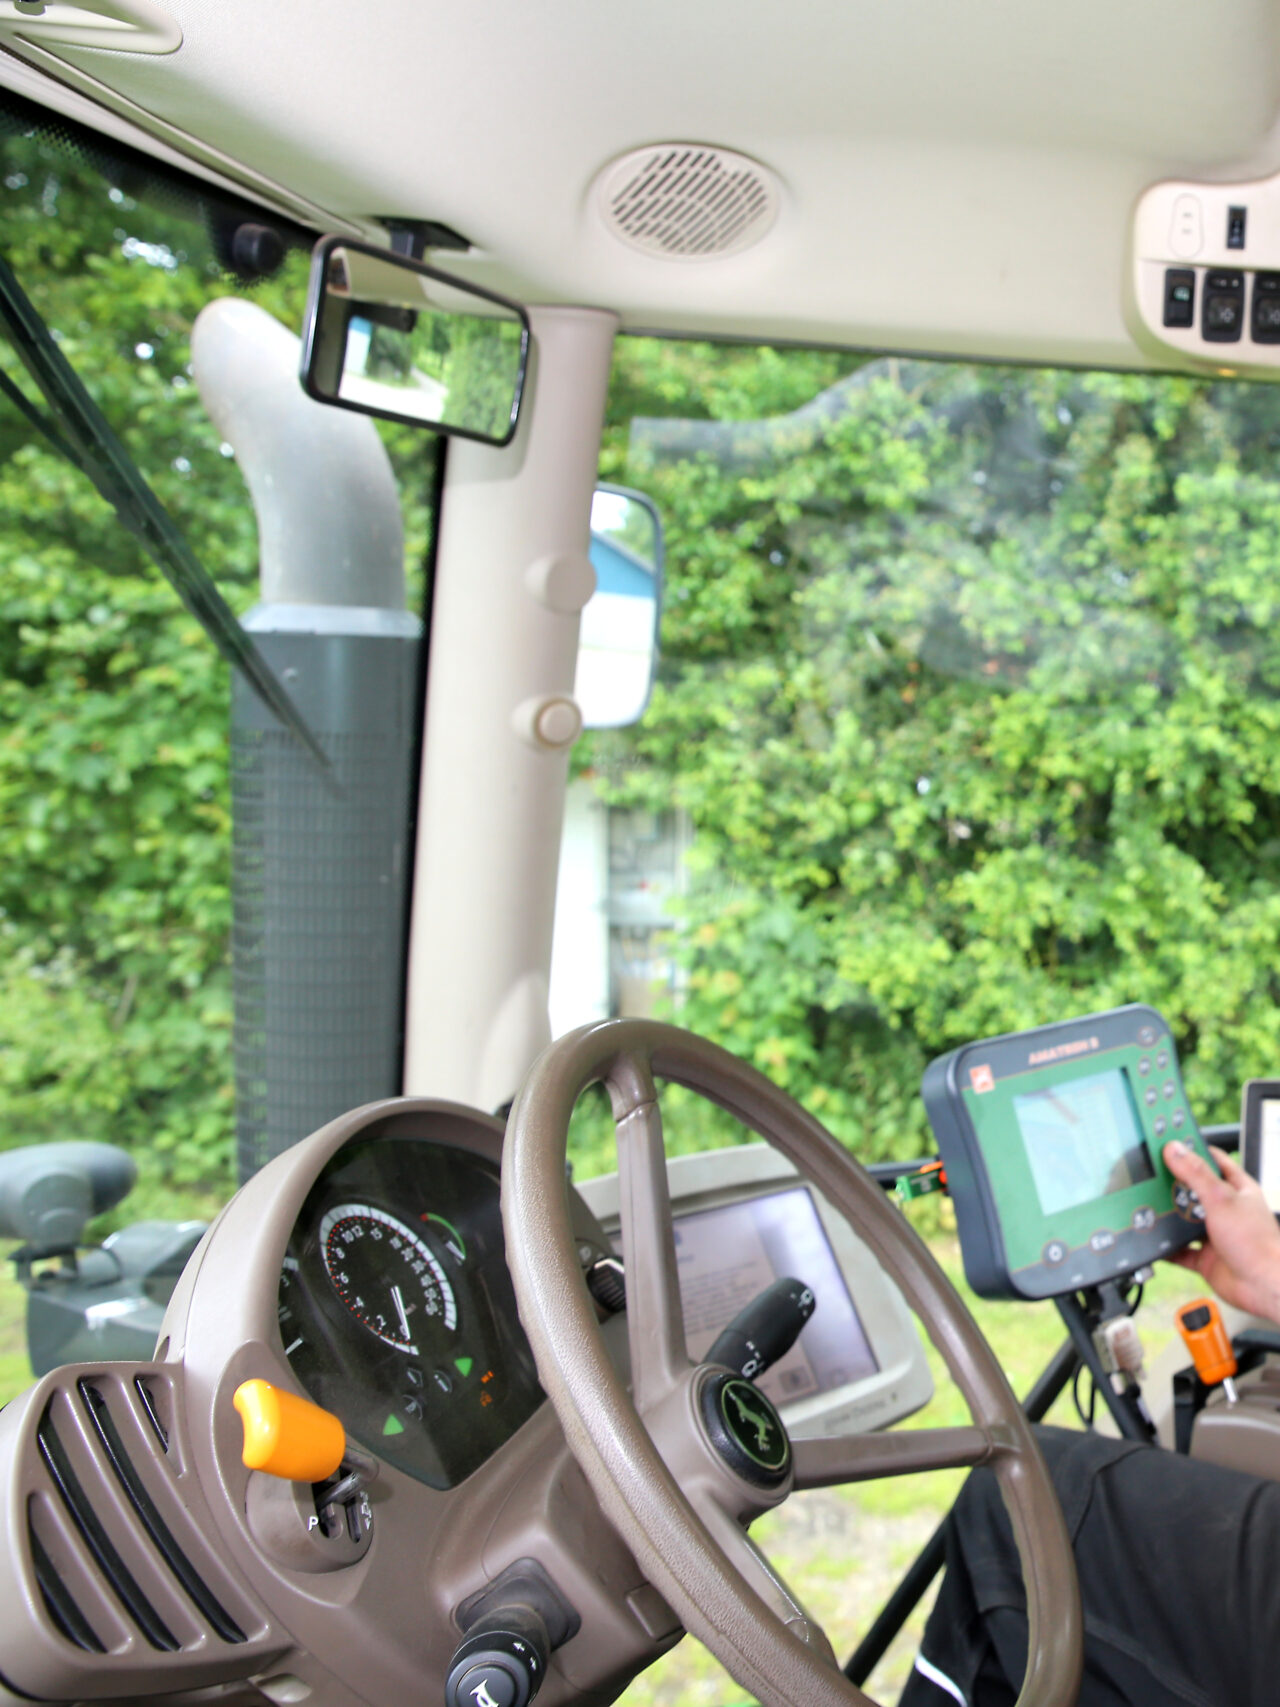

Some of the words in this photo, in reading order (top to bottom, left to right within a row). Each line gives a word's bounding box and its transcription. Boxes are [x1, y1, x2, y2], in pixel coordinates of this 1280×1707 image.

[351, 1224, 364, 1238] 12
[335, 1247, 345, 1259] 8
[340, 1271, 349, 1284] 6
[355, 1296, 364, 1308] 4
[376, 1314, 387, 1327] 2
[308, 1515, 319, 1531] P
